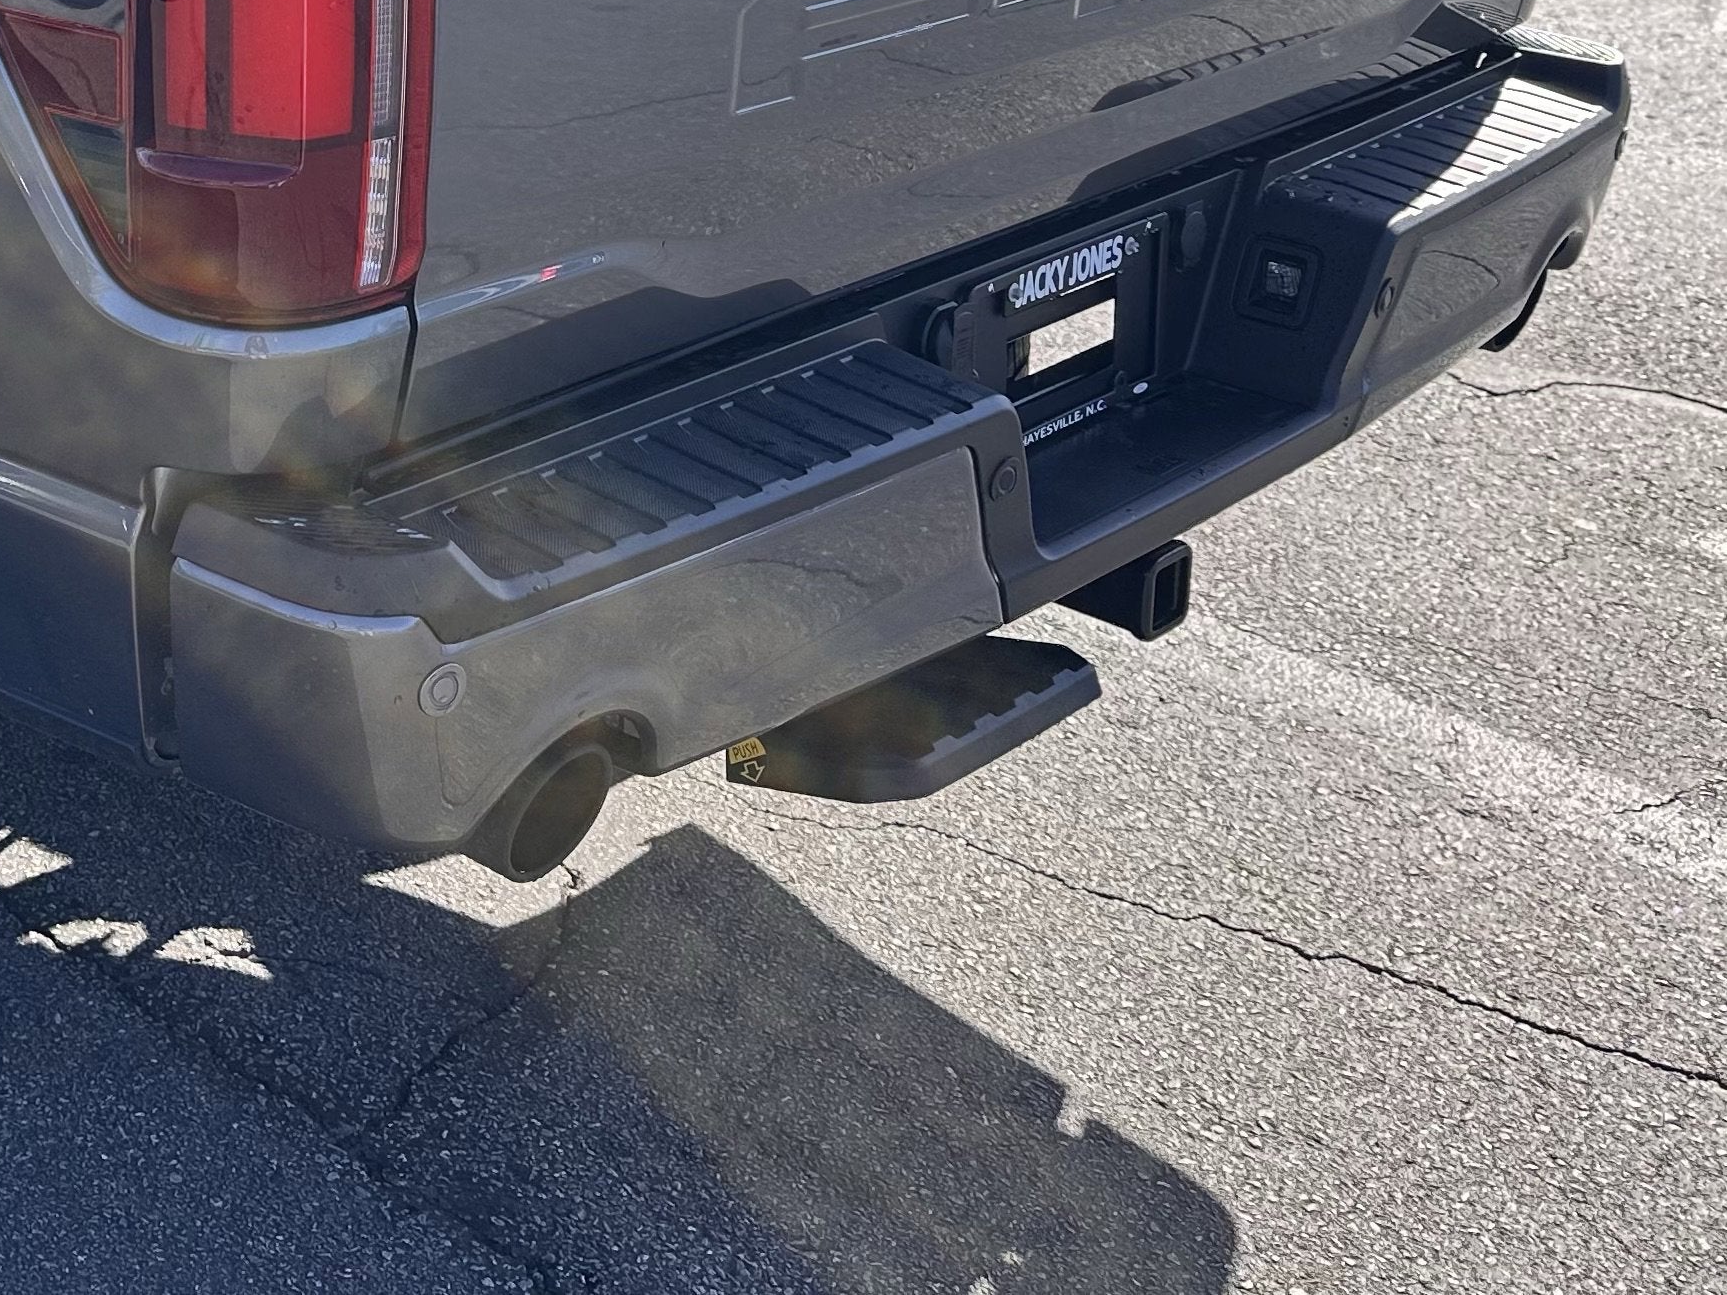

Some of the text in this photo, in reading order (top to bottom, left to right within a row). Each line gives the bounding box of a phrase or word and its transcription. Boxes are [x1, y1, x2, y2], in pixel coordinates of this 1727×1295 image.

[1014, 235, 1124, 309] JACKY JONES
[732, 740, 760, 761] PUSH
